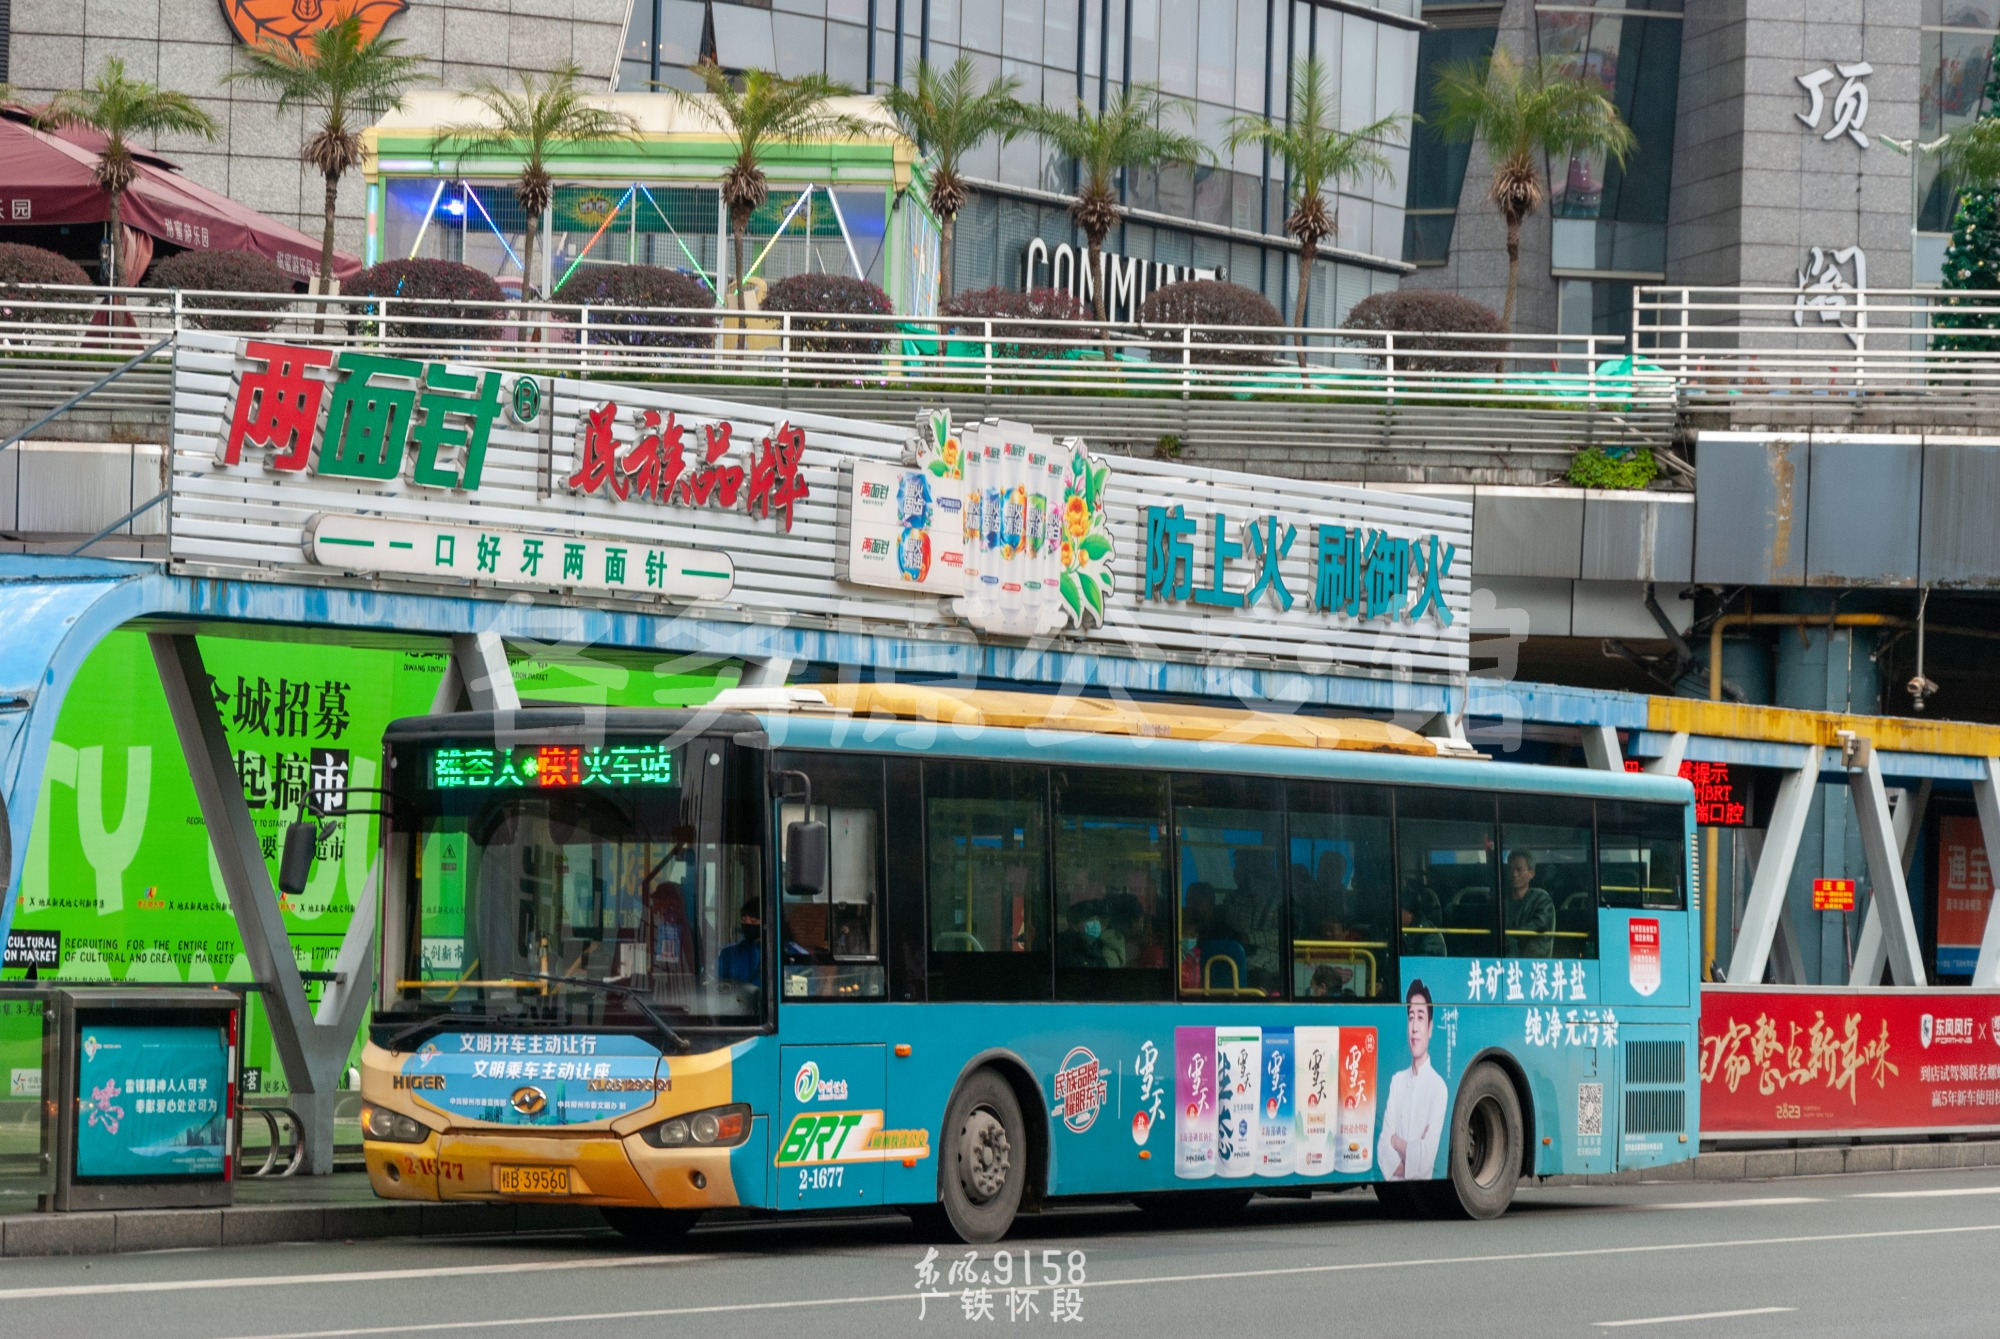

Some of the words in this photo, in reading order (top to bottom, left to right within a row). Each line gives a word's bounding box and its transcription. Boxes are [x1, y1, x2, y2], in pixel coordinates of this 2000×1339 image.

[1796, 61, 1873, 149] 顶
[222, 341, 504, 491] 两面针
[568, 402, 810, 533] 民族品牌
[860, 481, 889, 500] 两面针
[861, 537, 890, 556] 两面针
[1144, 505, 1297, 612] 防上火
[1313, 523, 1456, 628] 刷御火
[581, 746, 672, 785] 火车站
[8, 936, 57, 949] CULTURAL
[65, 938, 118, 949] RECRUITING
[127, 939, 145, 951] FOR
[153, 940, 170, 951] THE
[178, 940, 208, 951] ENTIRE
[216, 940, 235, 951] CITY
[20, 949, 57, 962] MARKET
[64, 951, 77, 962] OF
[80, 952, 126, 963] CULTURAL
[129, 952, 147, 964] AND
[150, 953, 192, 964] CREATIVE
[195, 953, 235, 965] MARKETS
[1467, 959, 1525, 1002] 井矿盐
[1530, 960, 1587, 1001] 深井盐
[1525, 1008, 1619, 1049] 纯净无污染
[1935, 1018, 1973, 1036] 东风风行
[458, 1032, 598, 1055] 文明开车主动让行
[471, 1059, 613, 1081] 文明乘车主动让座
[1055, 1059, 1099, 1099] 民族品牌
[125, 1077, 208, 1094] 雷锋精神人人可学
[392, 1075, 446, 1091] HIGER
[135, 1098, 218, 1114] 奉献爱心处处可为
[1064, 1081, 1107, 1119] 耀眼东方
[1776, 1103, 1801, 1119] 2023
[777, 1114, 863, 1163] BRT
[405, 1156, 464, 1181] 2-1677
[799, 1166, 844, 1190] 2-1677
